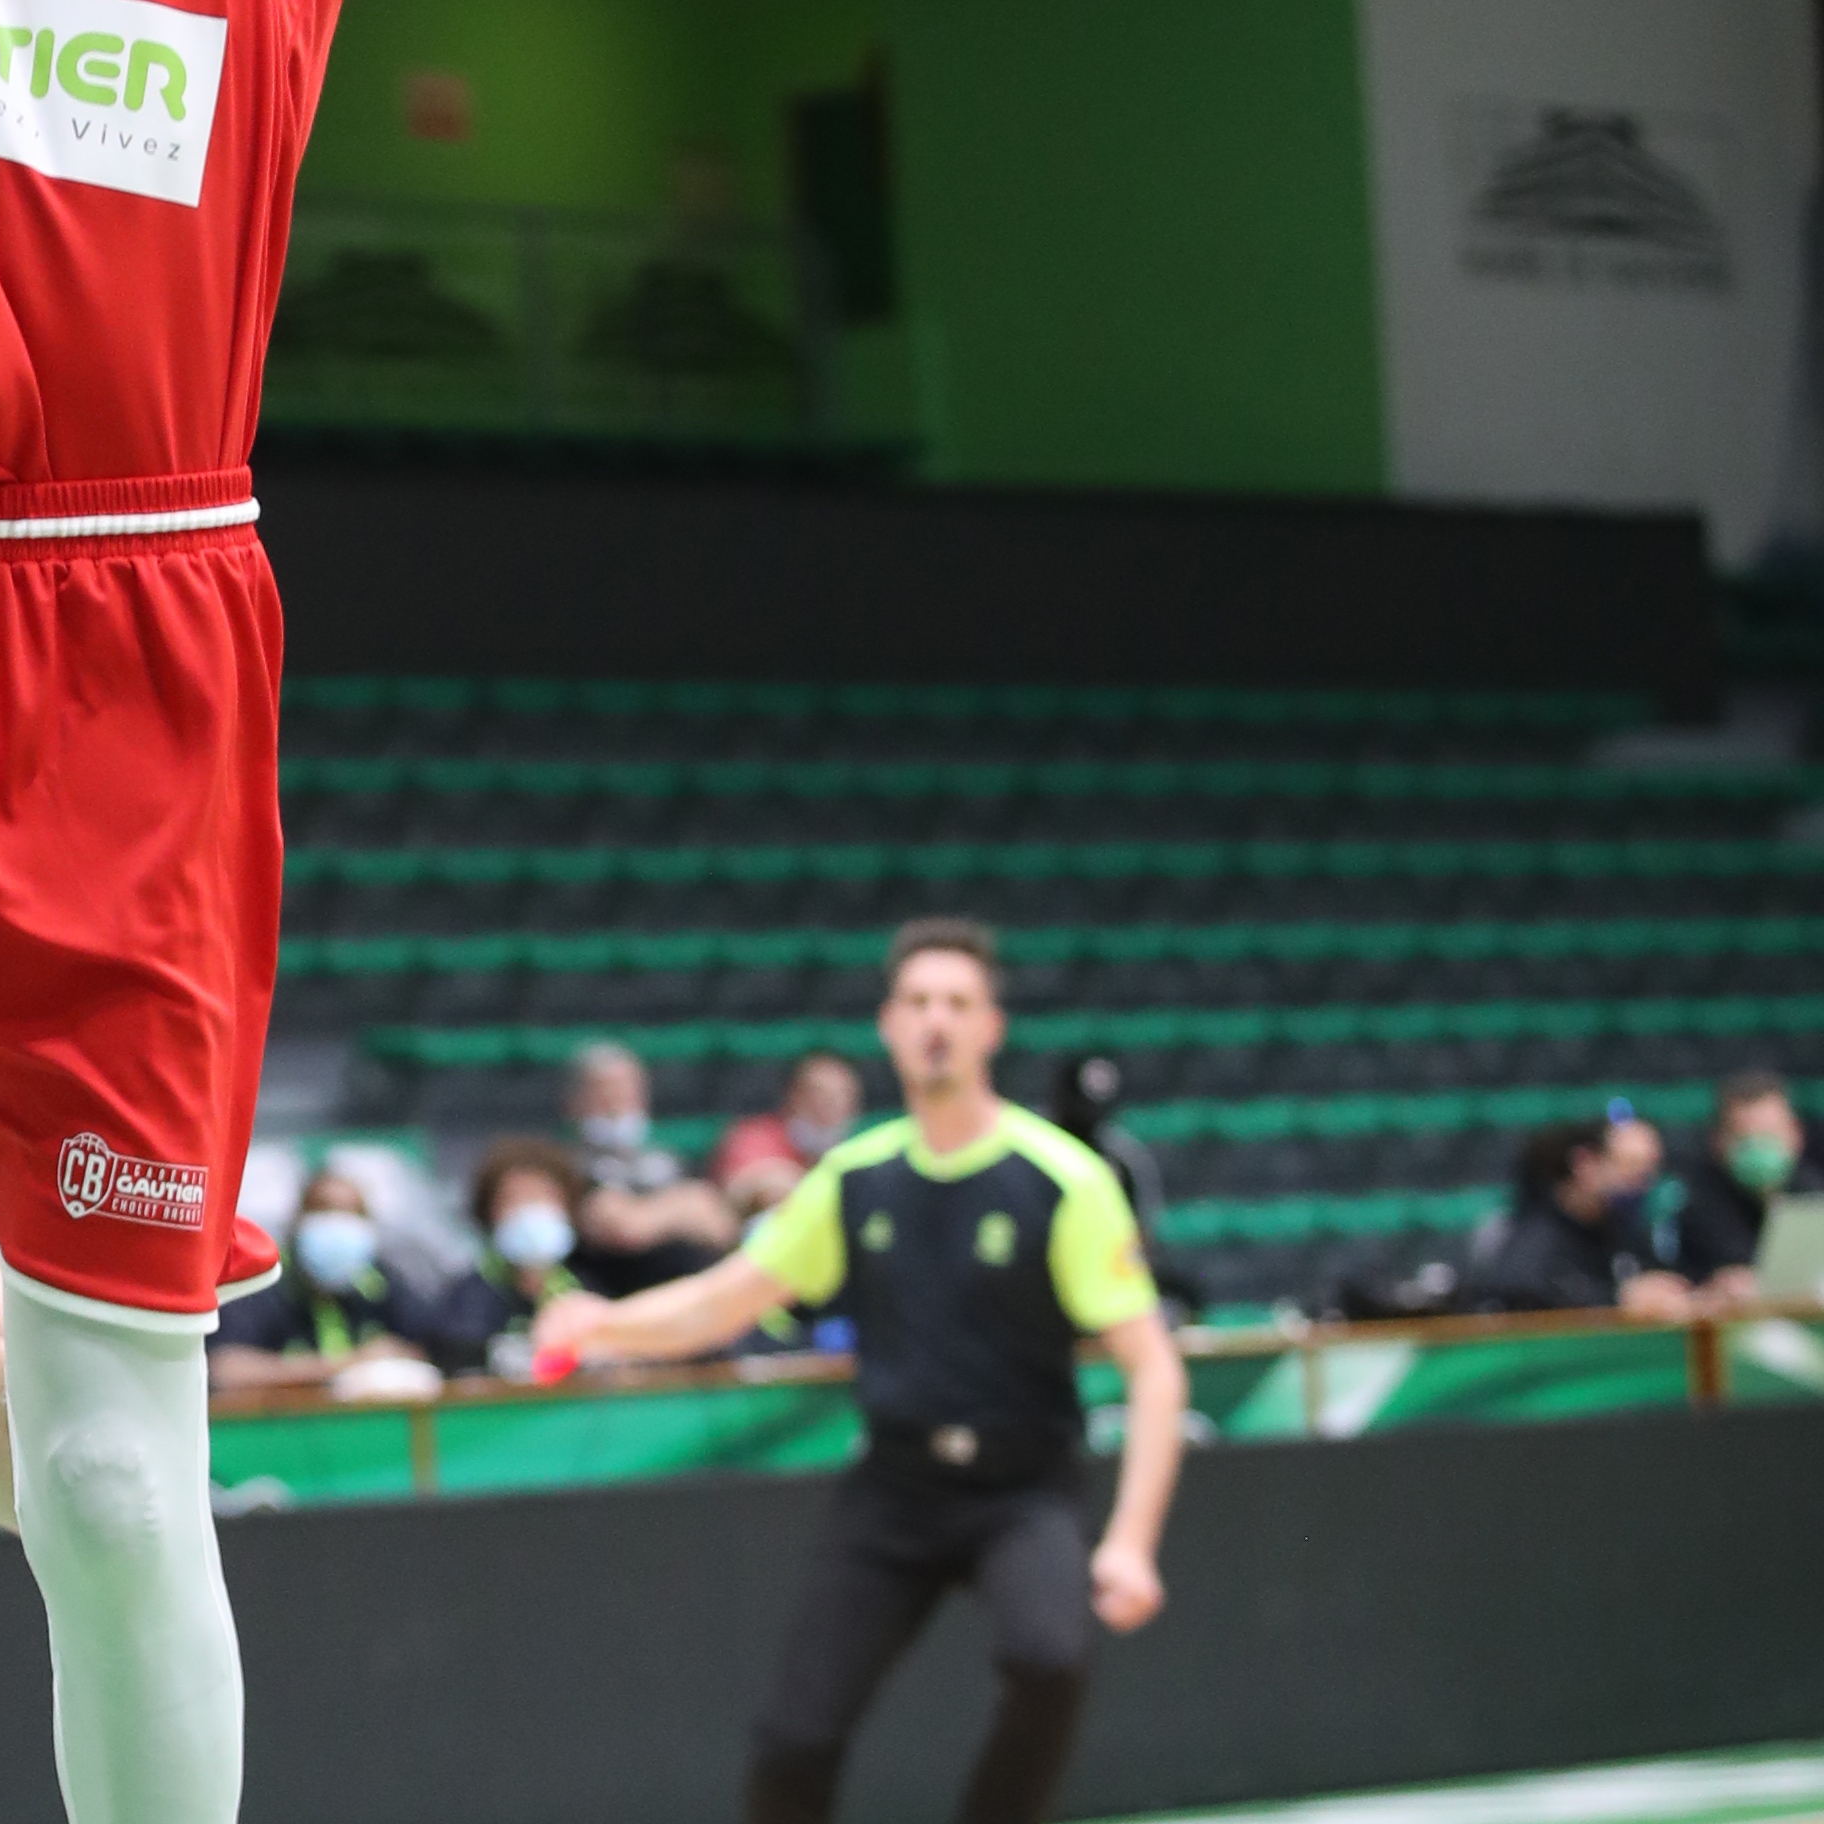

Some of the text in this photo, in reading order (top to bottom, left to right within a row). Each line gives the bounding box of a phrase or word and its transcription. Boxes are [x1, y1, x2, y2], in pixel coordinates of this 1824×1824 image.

[71, 118, 181, 161] Vivez
[62, 1147, 107, 1203] CB
[115, 1174, 204, 1205] GAUTIER
[111, 1197, 158, 1218] CHOLET
